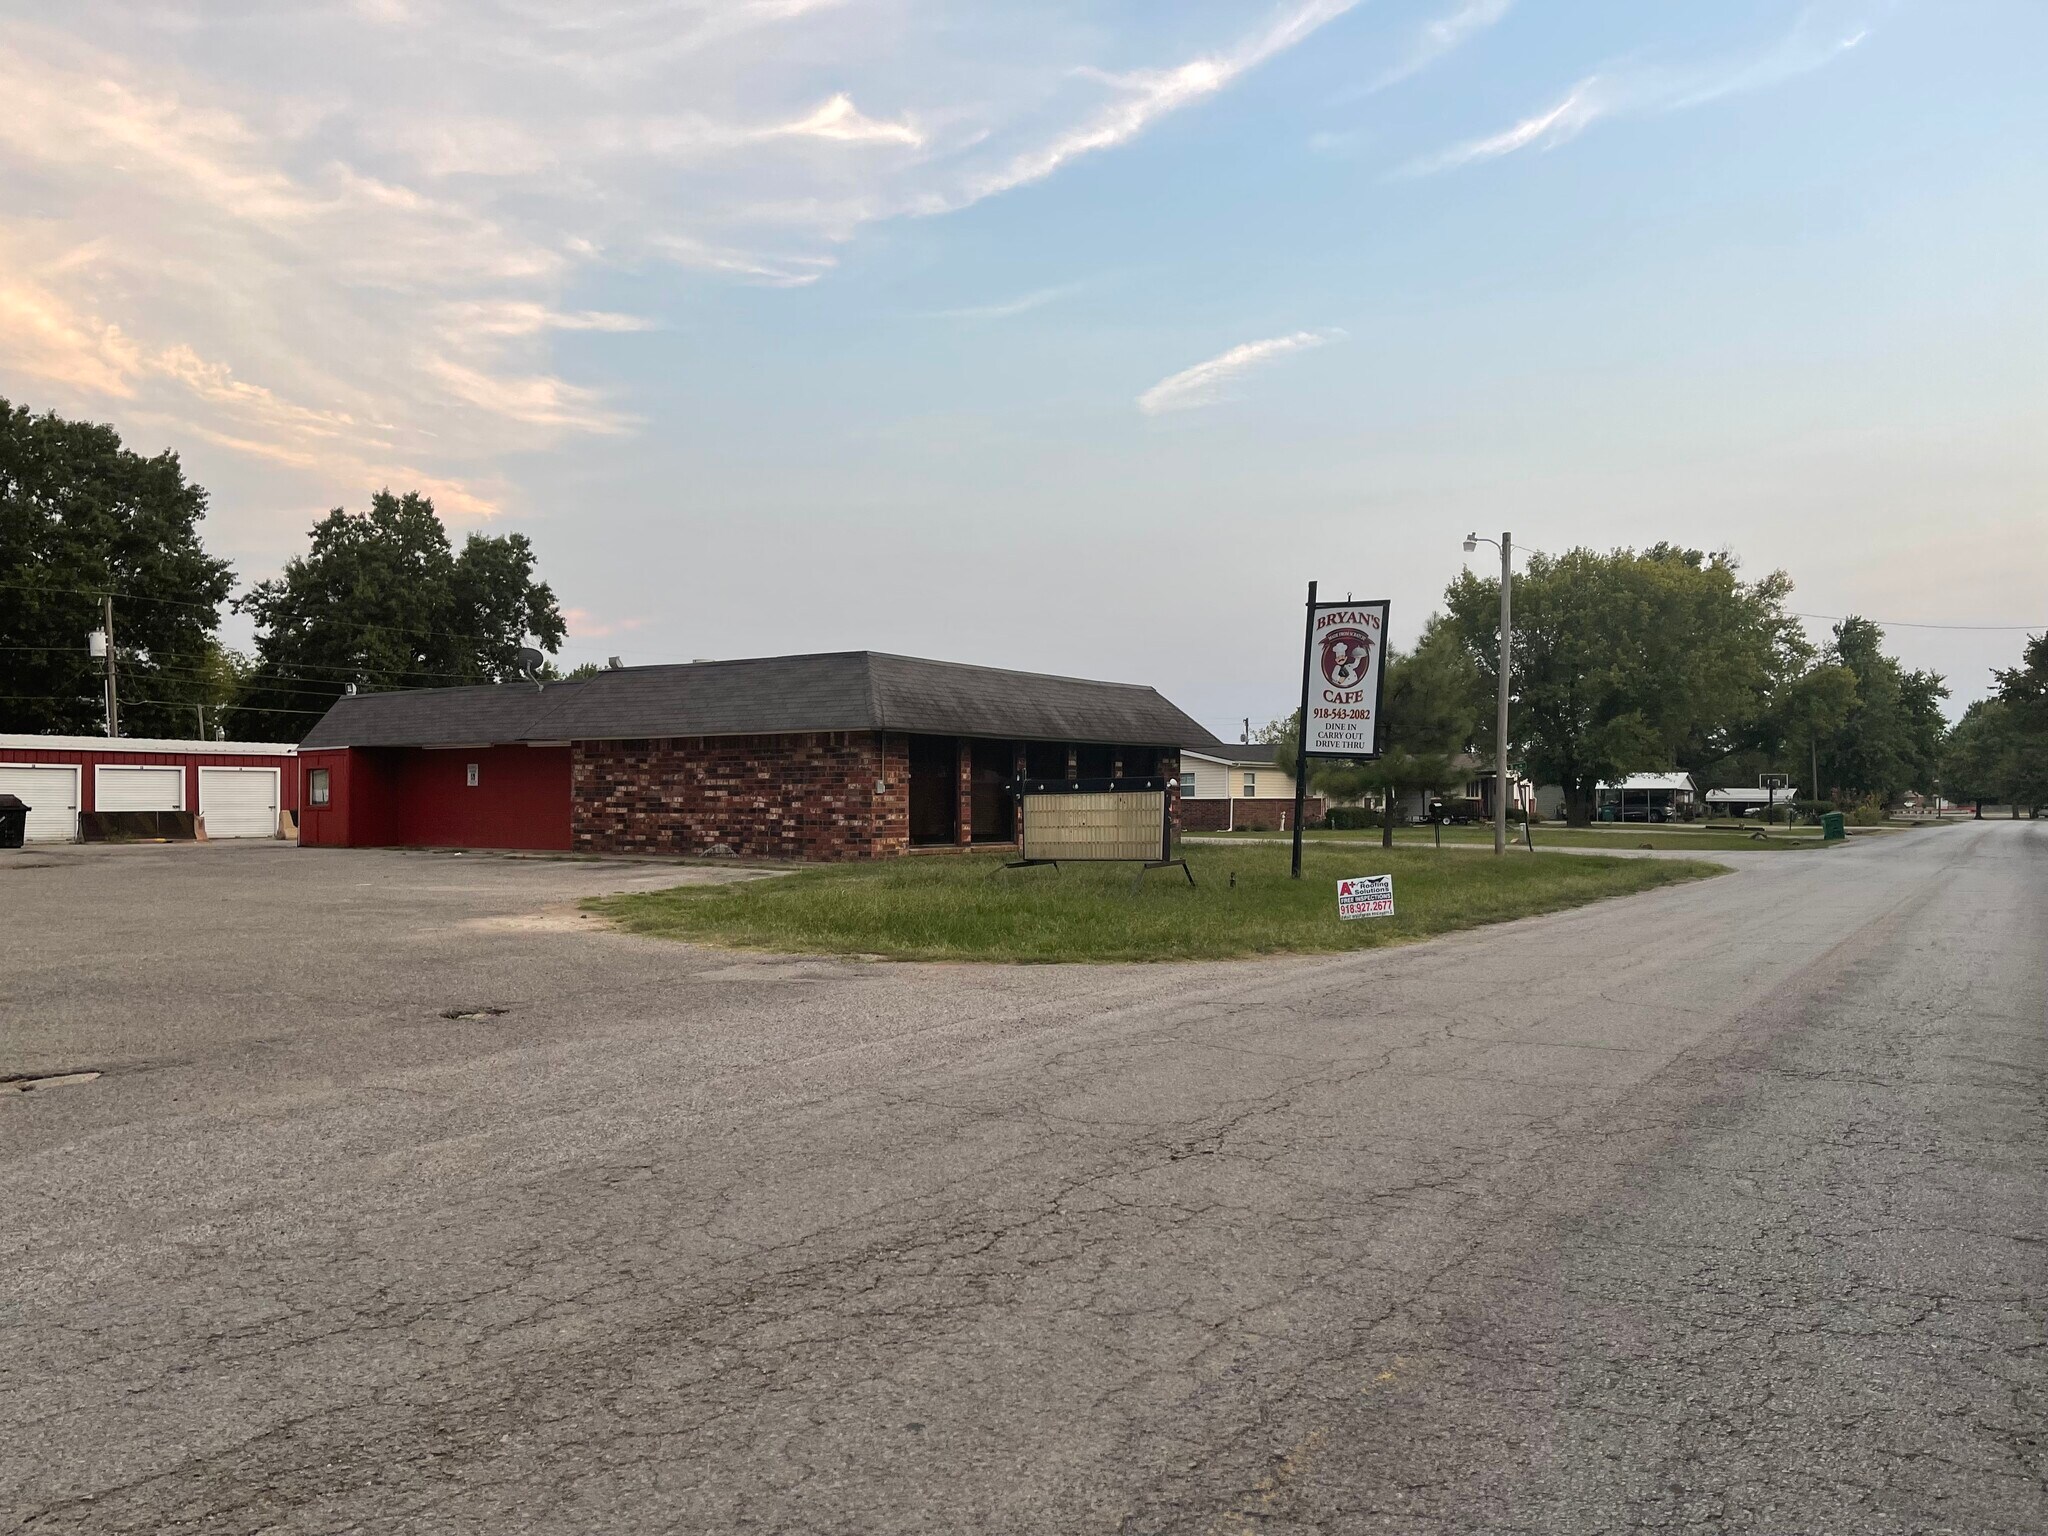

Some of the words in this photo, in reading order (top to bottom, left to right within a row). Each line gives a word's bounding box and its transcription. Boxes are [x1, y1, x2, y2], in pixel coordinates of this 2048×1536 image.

[1316, 611, 1380, 630] BRYAN'S
[1323, 689, 1364, 704] CAFE
[1313, 708, 1370, 719] 918-543-2082
[1325, 723, 1346, 731] DINE
[1347, 723, 1357, 731] IN
[1317, 731, 1344, 740] CARRY
[1345, 732, 1364, 740] OUT
[1315, 740, 1341, 748] DRIVE
[1342, 741, 1365, 749] THRU
[1340, 881, 1355, 896] A+
[1354, 887, 1390, 895] Solutions
[1340, 900, 1392, 915] 918.927.2677
